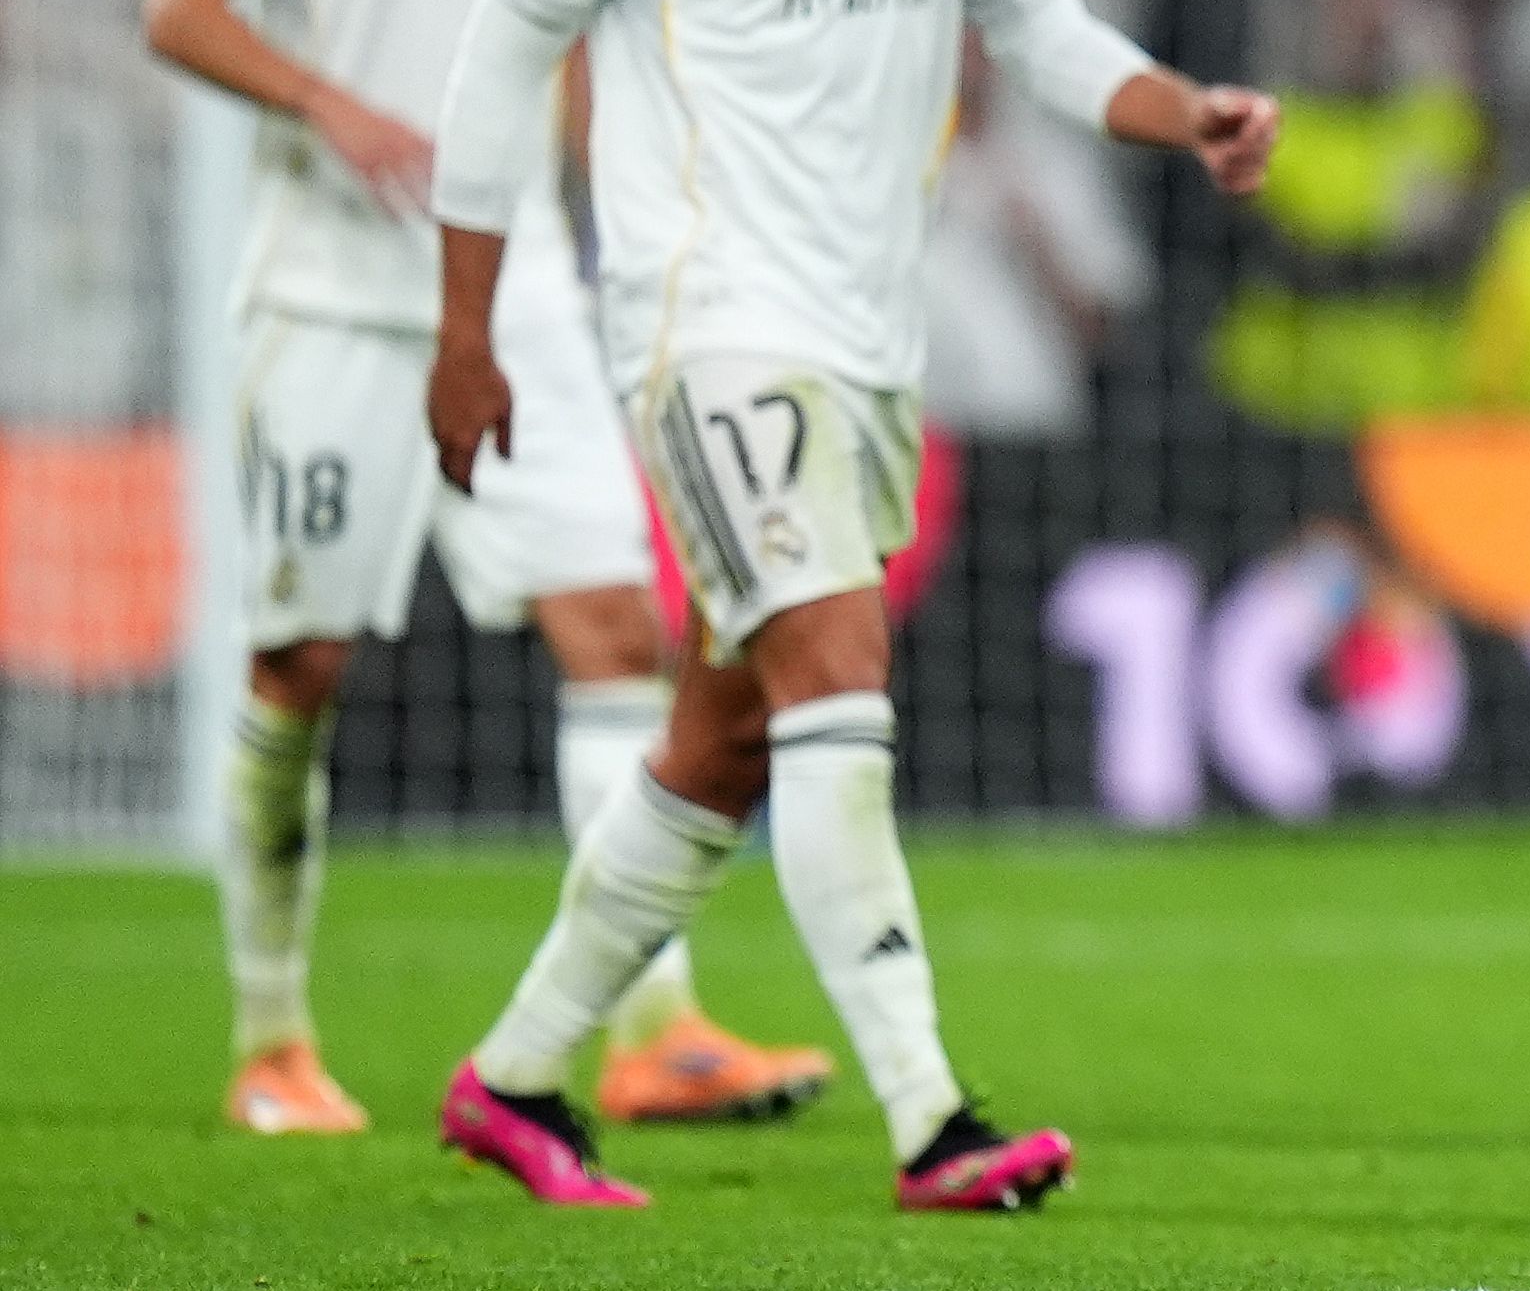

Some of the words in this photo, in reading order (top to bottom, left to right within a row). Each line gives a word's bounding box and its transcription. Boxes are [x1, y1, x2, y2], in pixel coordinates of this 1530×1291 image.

[708, 392, 808, 496] 17
[264, 448, 349, 546] 18
[1042, 538, 1472, 824] 10
